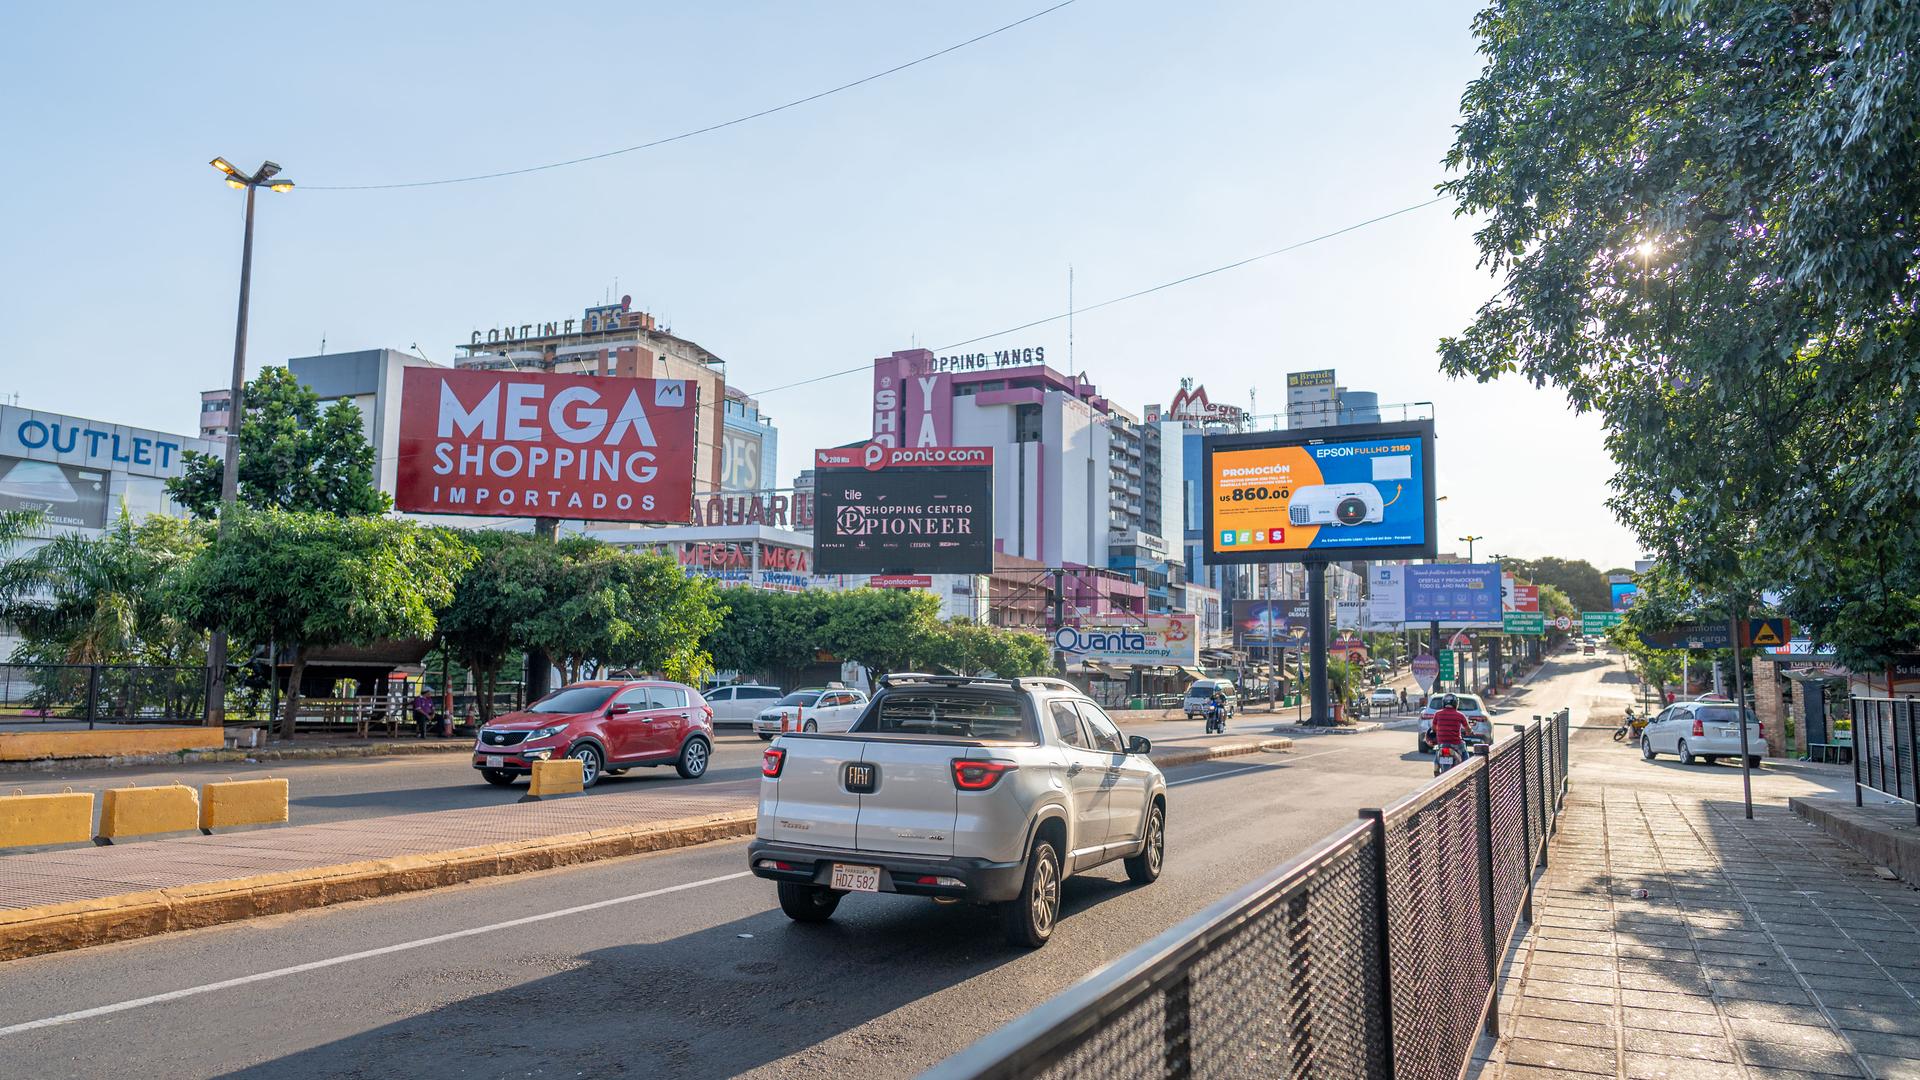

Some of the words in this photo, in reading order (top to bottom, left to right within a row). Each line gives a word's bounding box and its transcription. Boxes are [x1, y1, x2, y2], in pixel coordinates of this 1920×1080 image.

[437, 377, 658, 448] MEGA
[18, 420, 179, 468] OUTLET
[891, 449, 945, 464] ponto
[948, 450, 985, 461] com
[1316, 447, 1354, 458] EPSON
[1354, 446, 1389, 455] FULLHD
[432, 442, 658, 484] SHOPPING
[1222, 464, 1290, 477] PROMOCIÓN
[433, 486, 656, 511] IMPORTADOS
[844, 489, 862, 500] tile
[1232, 487, 1290, 502] 860.00
[865, 505, 922, 515] SHOPPING
[927, 505, 973, 514] CENTRO
[865, 518, 972, 535] PIONEER
[1683, 624, 1727, 632] camiones
[1055, 627, 1145, 655] Quanta
[1686, 635, 1698, 643] de
[1699, 636, 1727, 645] carga
[1896, 665, 1907, 674] Su
[849, 766, 870, 785] FIAT
[835, 873, 854, 888] HDZ
[856, 875, 875, 890] 582
